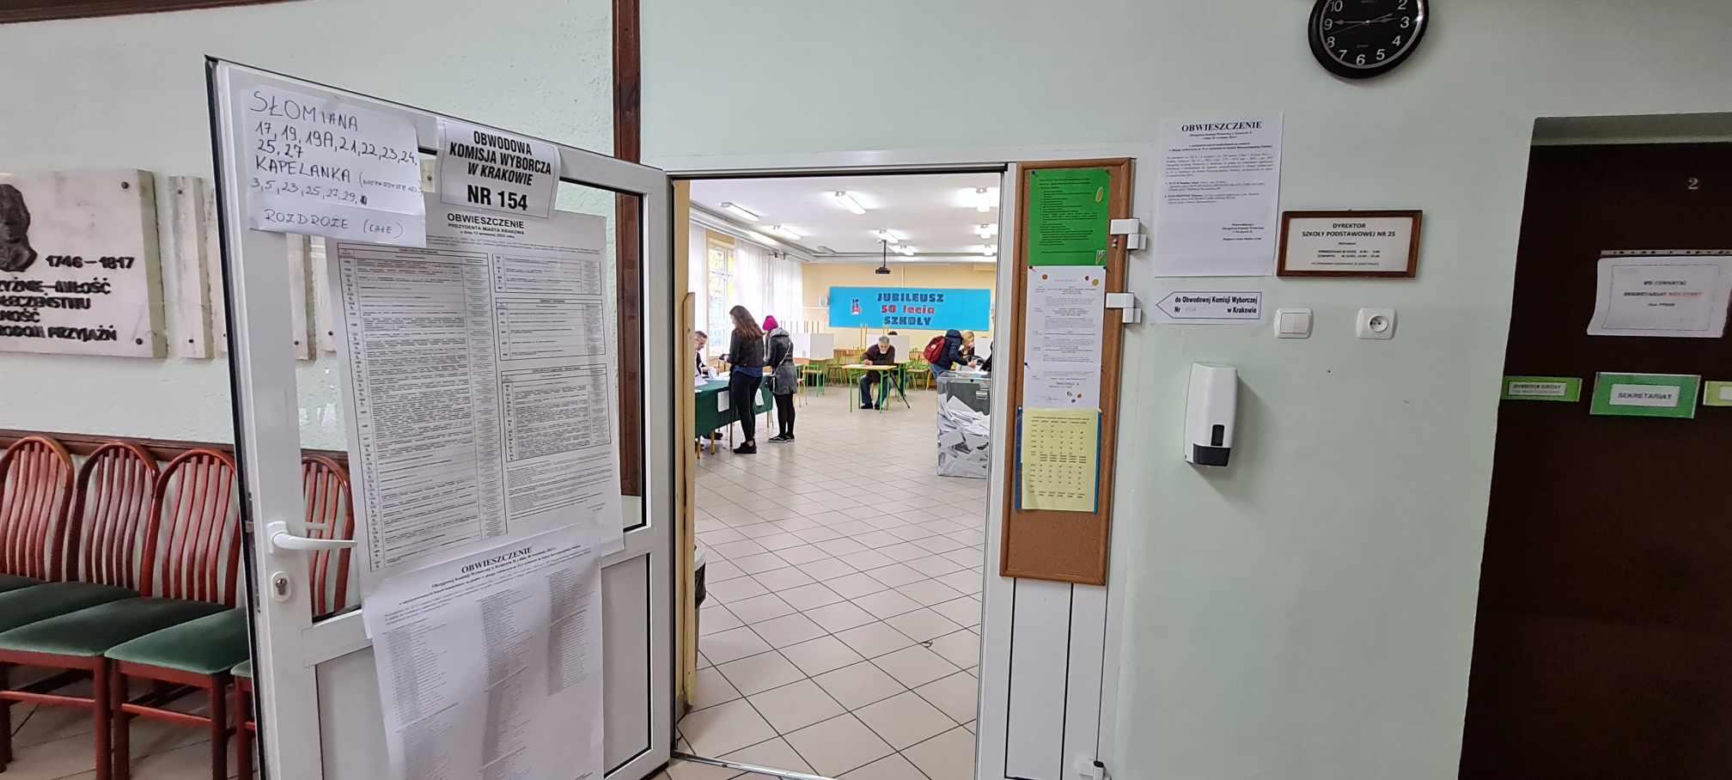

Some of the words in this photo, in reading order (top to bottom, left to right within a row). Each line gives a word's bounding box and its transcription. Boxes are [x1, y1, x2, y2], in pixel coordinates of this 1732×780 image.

[1331, 0, 1343, 12] 10
[1398, 0, 1407, 10] 2
[1324, 18, 1333, 30] 9
[1400, 16, 1410, 28] 3
[1327, 36, 1335, 48] 8
[1392, 35, 1401, 46] 4
[1338, 49, 1348, 60] 7
[1356, 54, 1366, 66] 6
[1376, 48, 1386, 60] 5
[1182, 121, 1262, 132] OBWIESZCZENIE
[474, 131, 532, 156] OBWODOWA
[449, 142, 497, 165] KOMISJA
[500, 152, 551, 175] WYBORCZA
[256, 155, 351, 183] KAPELANKA
[467, 162, 480, 175] W
[481, 166, 533, 186] KRAKOWIE
[1688, 178, 1699, 190] 2
[467, 185, 491, 206] NR
[497, 191, 528, 211] 154
[447, 212, 525, 229] OBWIESZCZENIE
[877, 293, 945, 303] JUBILEUSZ
[1183, 296, 1211, 304] Obwodowej
[1212, 296, 1231, 304] Komisji
[1232, 296, 1258, 304] Wyborczej
[881, 305, 896, 314] 50
[884, 316, 932, 326] SZKOŁY
[1618, 391, 1672, 400] SEKRETARIAT
[461, 547, 533, 574] OBWIESZCZENIE
